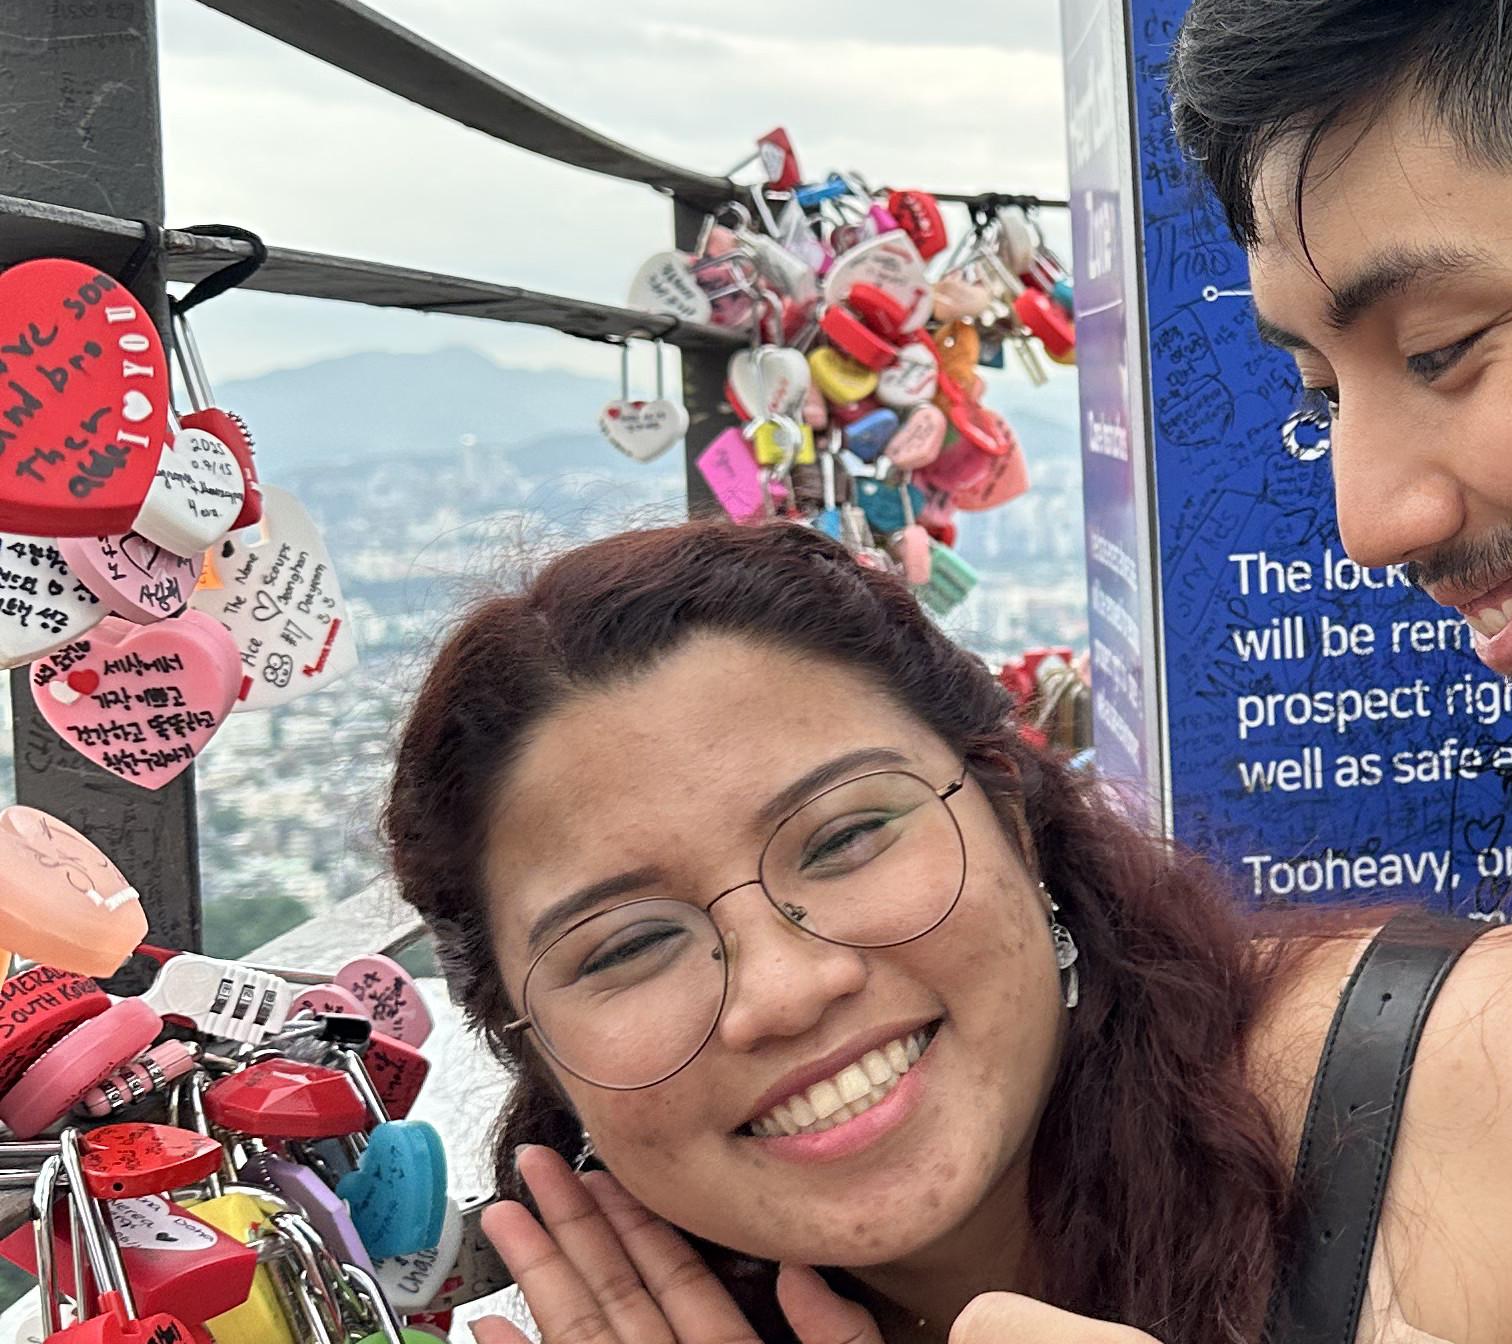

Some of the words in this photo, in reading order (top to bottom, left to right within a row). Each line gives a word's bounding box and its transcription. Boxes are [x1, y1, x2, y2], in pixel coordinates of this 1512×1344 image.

[105, 305, 155, 379] YOU
[1229, 550, 1313, 596] The
[1324, 548, 1411, 591] lock
[1232, 615, 1305, 662] will
[1321, 615, 1376, 658] be
[1391, 617, 1477, 655] rem
[103, 651, 184, 677] 세상에서
[91, 686, 132, 711] 가장
[1237, 679, 1432, 740] prospect
[67, 720, 147, 746] 건강하고
[1238, 746, 1322, 794] well
[1334, 753, 1383, 787] as
[1392, 738, 1481, 783] safe
[1242, 848, 1460, 895] Tooheavy,
